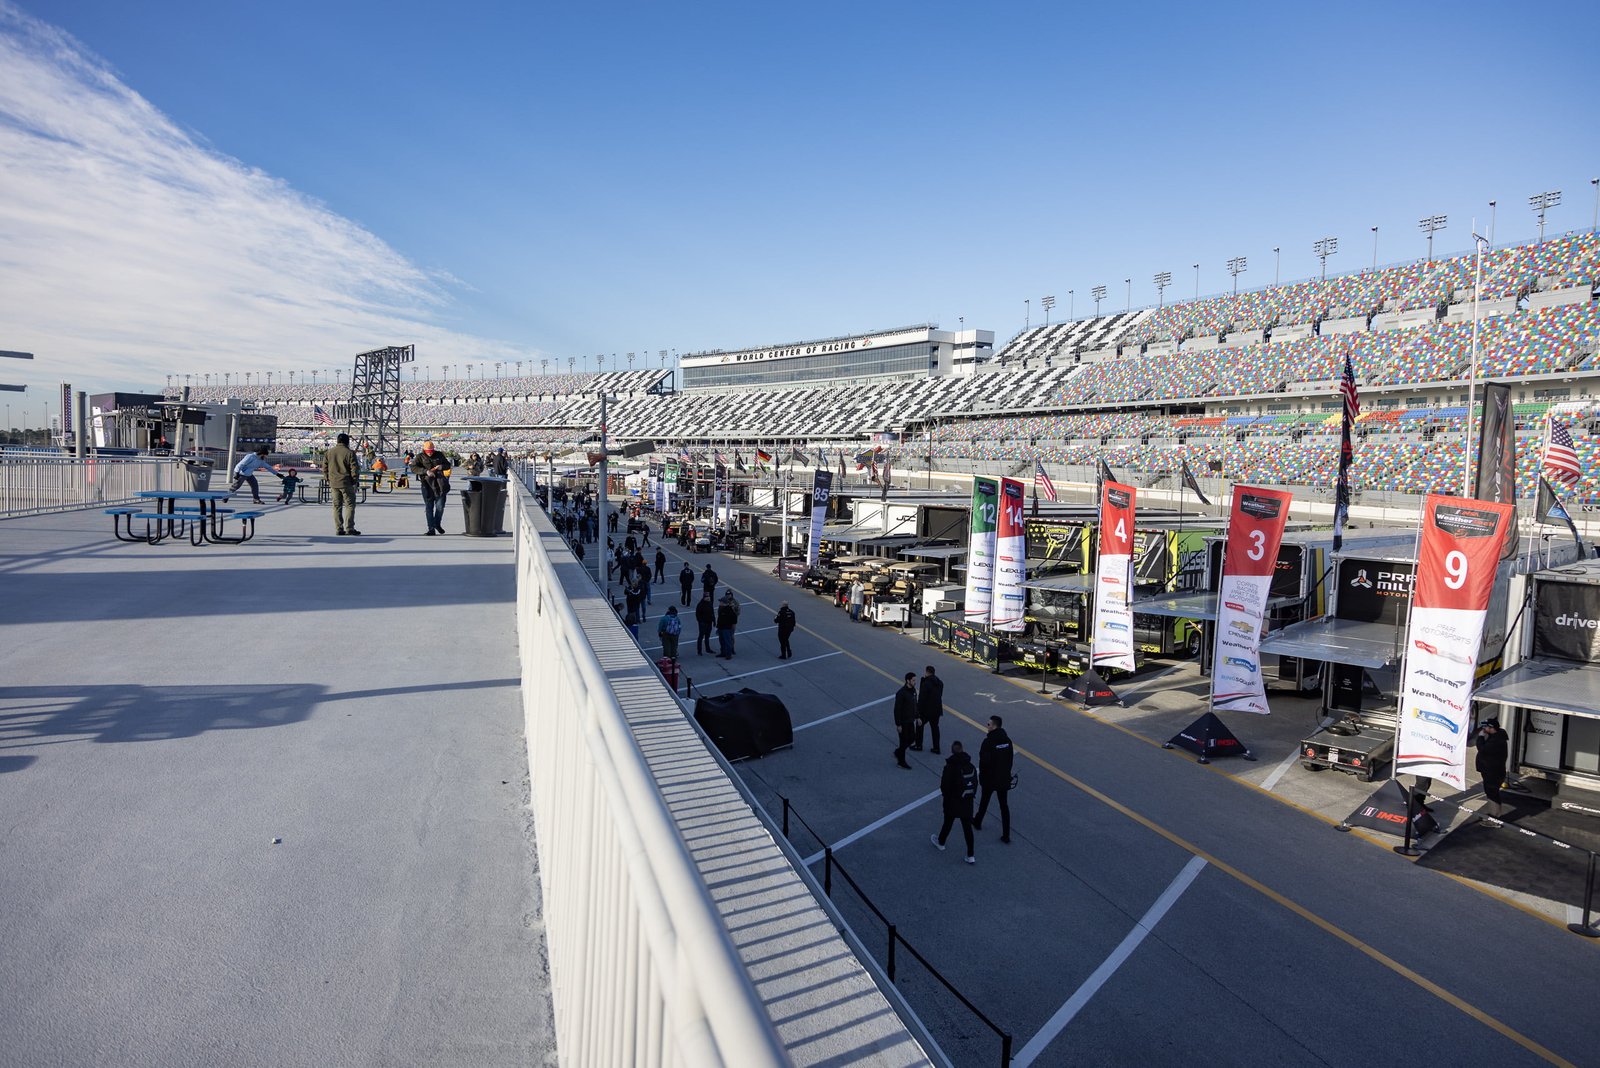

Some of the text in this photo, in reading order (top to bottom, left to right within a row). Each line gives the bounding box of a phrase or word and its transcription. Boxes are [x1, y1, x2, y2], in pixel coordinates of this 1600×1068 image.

[736, 341, 856, 362] WORLD CENTER OF RACING
[666, 473, 677, 481] 45
[813, 487, 829, 501] 85
[980, 502, 995, 524] 12
[1006, 505, 1024, 528] 14
[1114, 517, 1128, 543] 4
[1247, 529, 1265, 561] 3
[1444, 550, 1468, 589] 9
